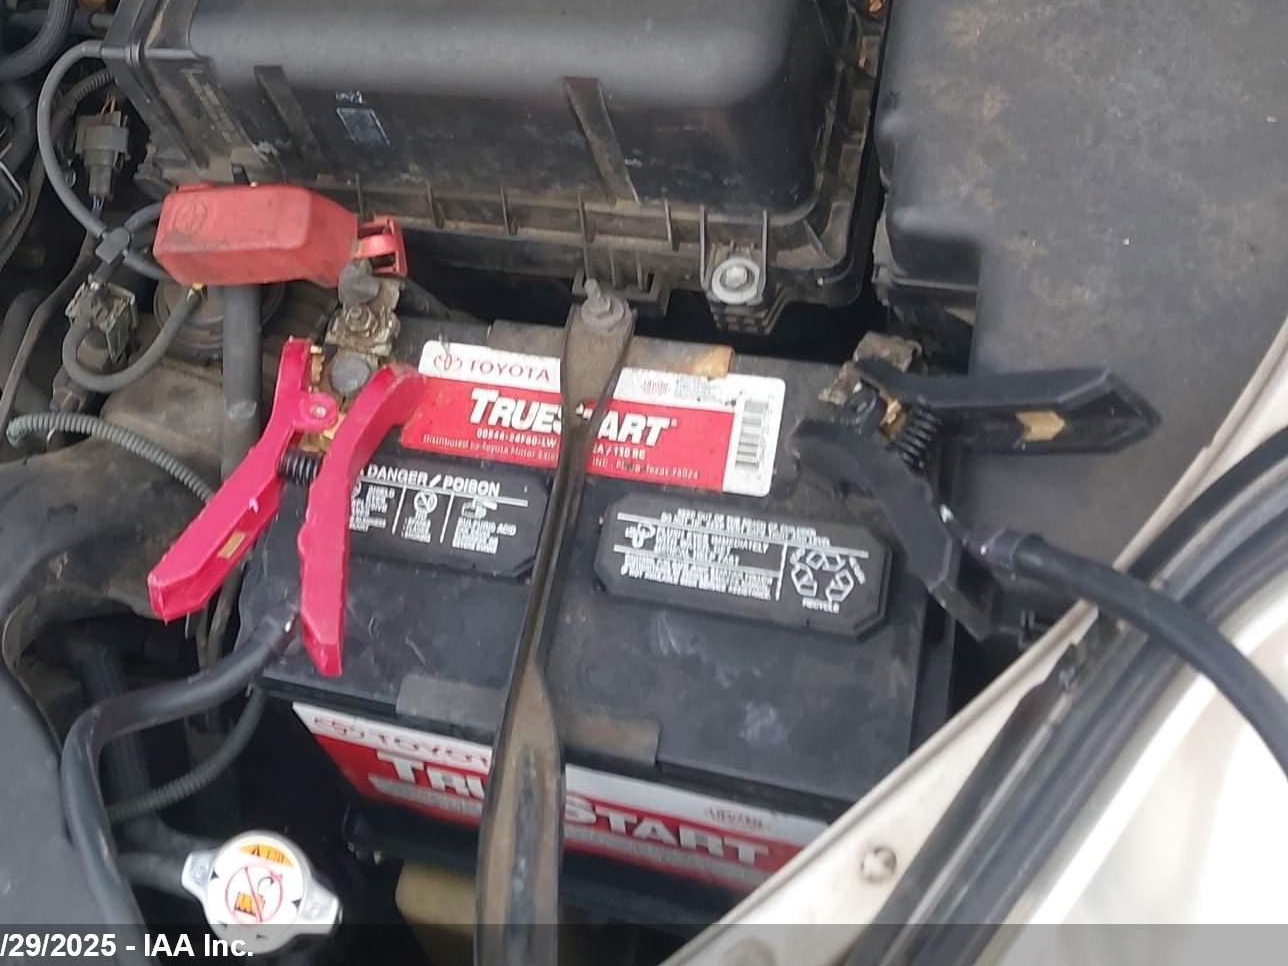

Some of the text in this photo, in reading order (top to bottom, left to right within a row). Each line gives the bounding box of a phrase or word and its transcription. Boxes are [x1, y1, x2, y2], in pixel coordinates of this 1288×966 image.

[469, 359, 550, 383] TOYOTA
[469, 386, 671, 447] TRUEART
[367, 463, 428, 488] DANGER
[378, 733, 491, 769] TOYOT
[376, 748, 770, 866] TRSTART
